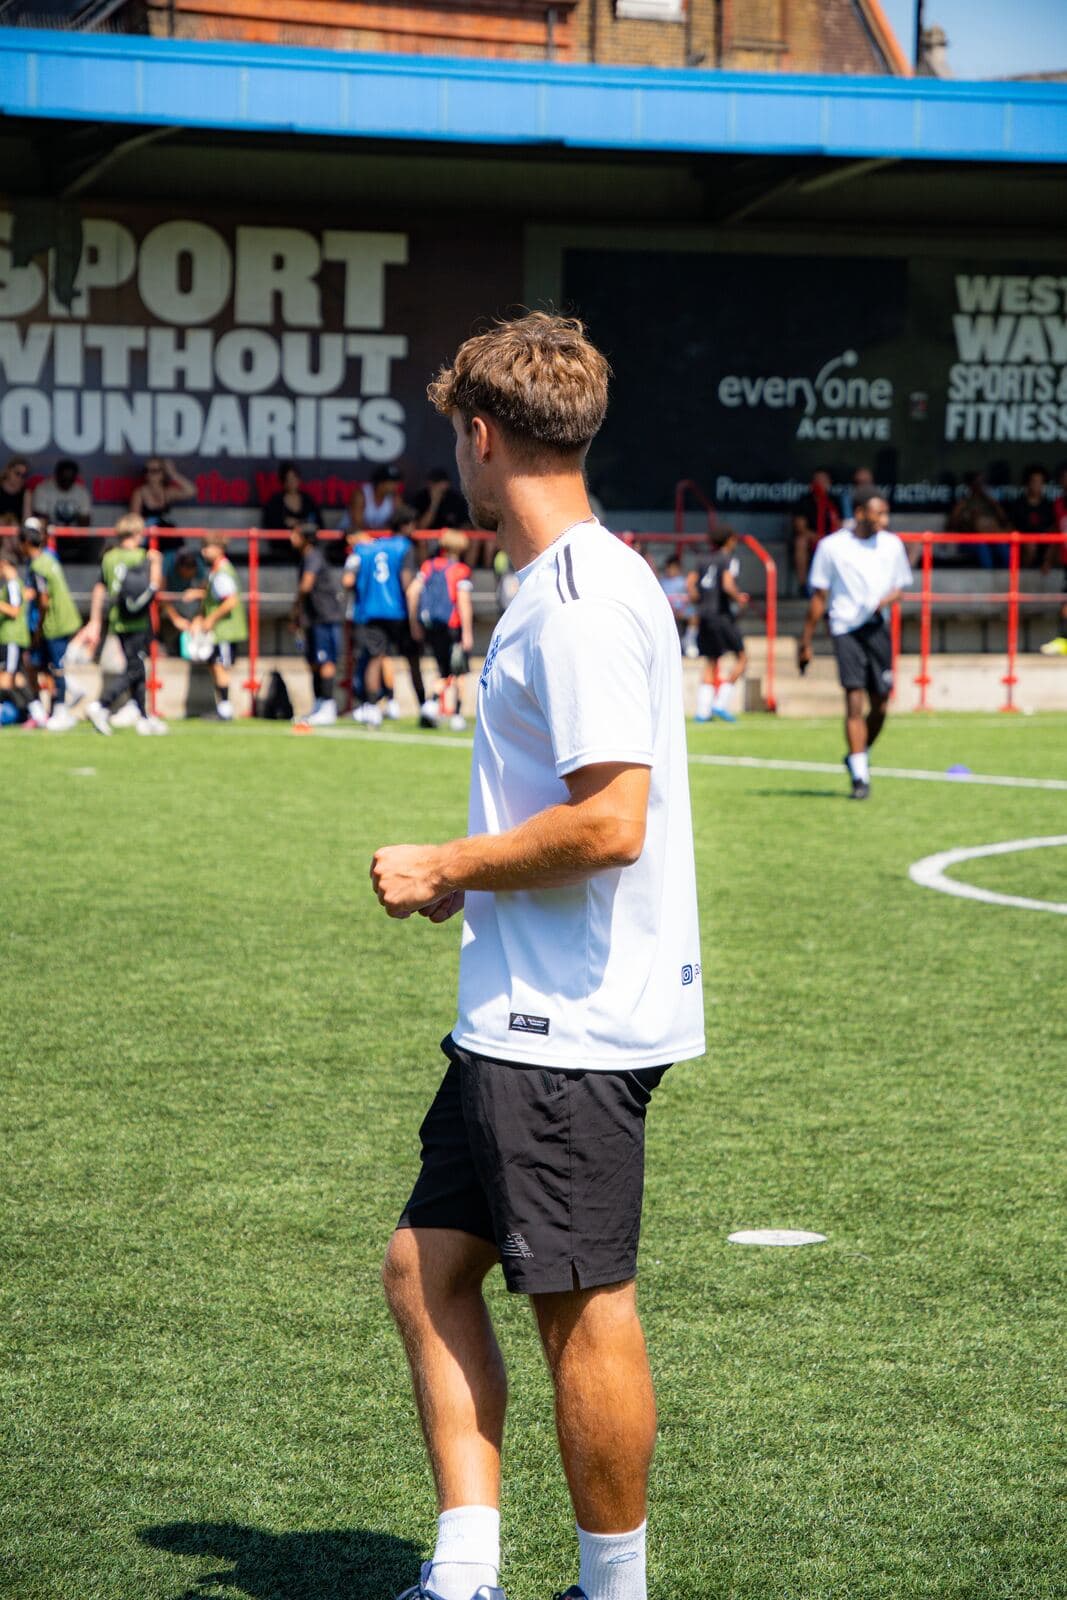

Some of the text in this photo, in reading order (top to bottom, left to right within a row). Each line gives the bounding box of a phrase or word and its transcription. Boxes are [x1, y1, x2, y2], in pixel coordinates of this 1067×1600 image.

[954, 274, 1067, 315] WES
[718, 350, 893, 417] everyone
[948, 364, 1056, 402] SPORTS
[797, 417, 891, 441] ACTIVE
